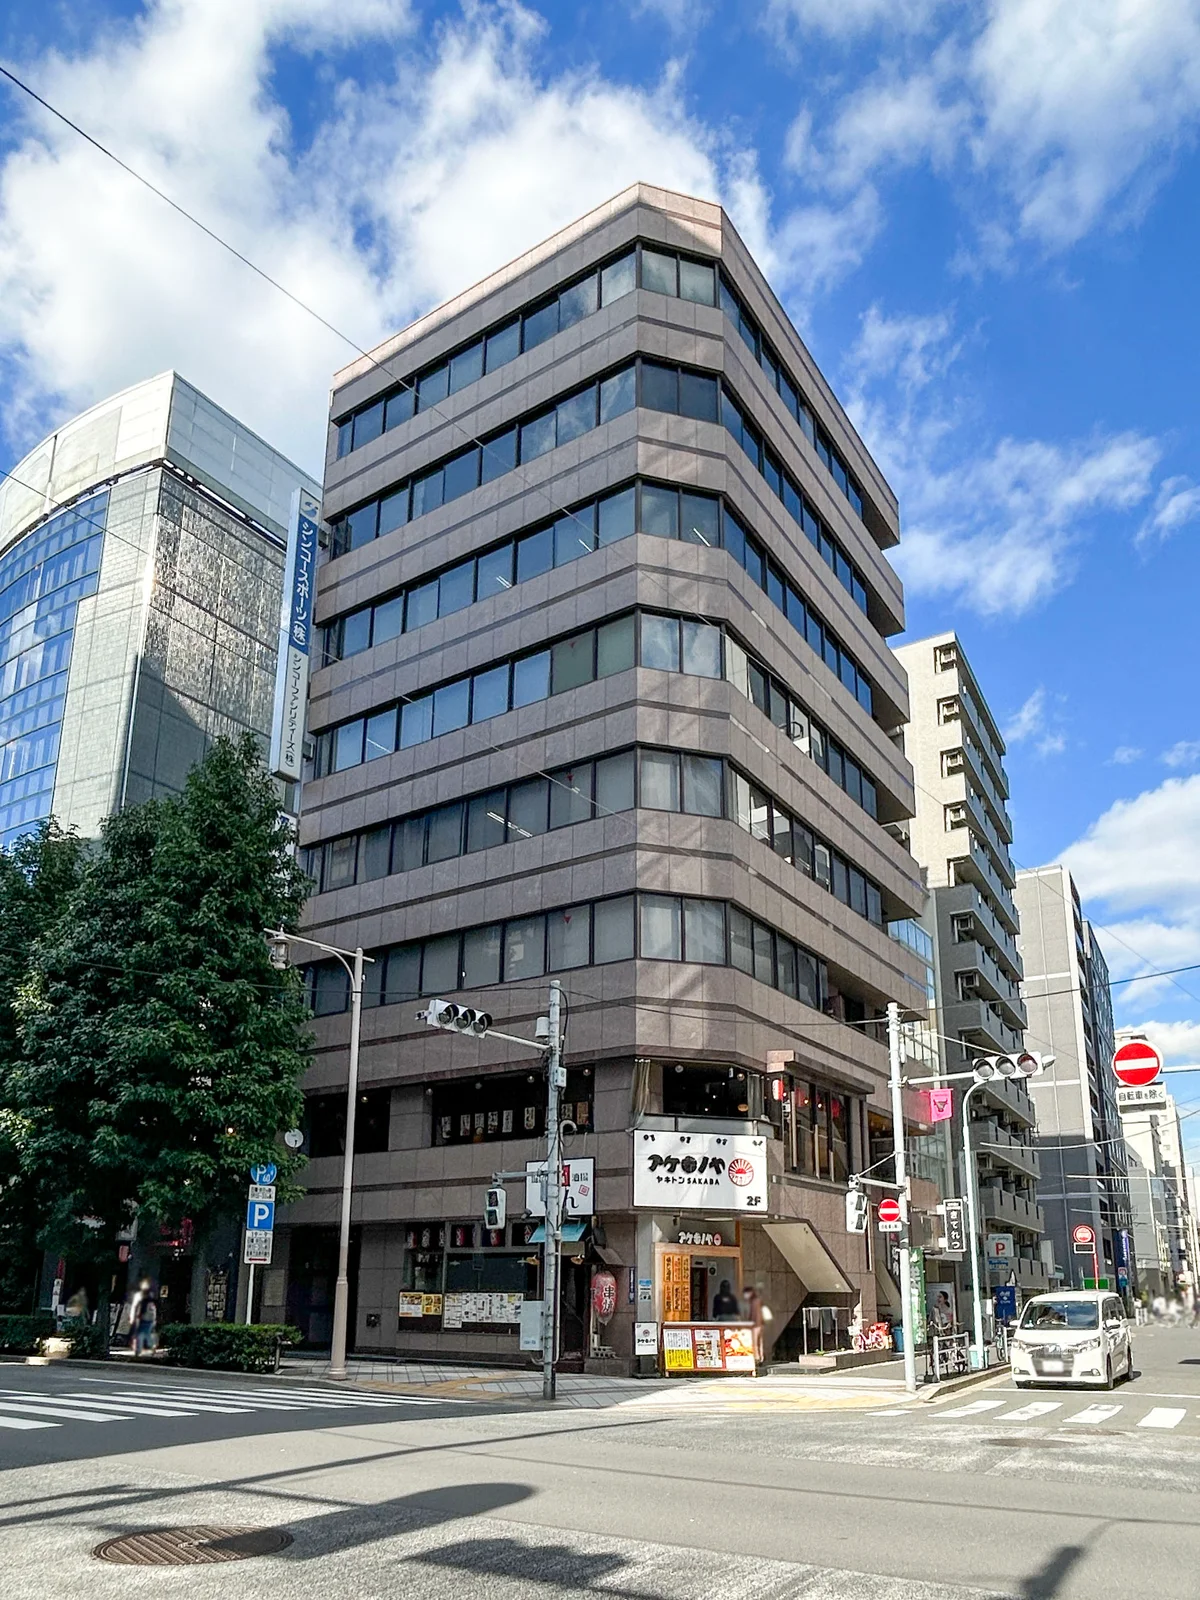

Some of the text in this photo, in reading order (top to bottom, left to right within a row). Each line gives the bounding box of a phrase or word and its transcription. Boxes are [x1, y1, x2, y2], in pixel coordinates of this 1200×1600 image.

[1118, 1089, 1164, 1102] 自転車を除く
[656, 1175, 686, 1185] ヤキトン
[687, 1177, 720, 1186] SAKABA
[747, 1195, 762, 1207] 2F
[253, 1203, 270, 1228] P
[995, 1242, 1006, 1256] P
